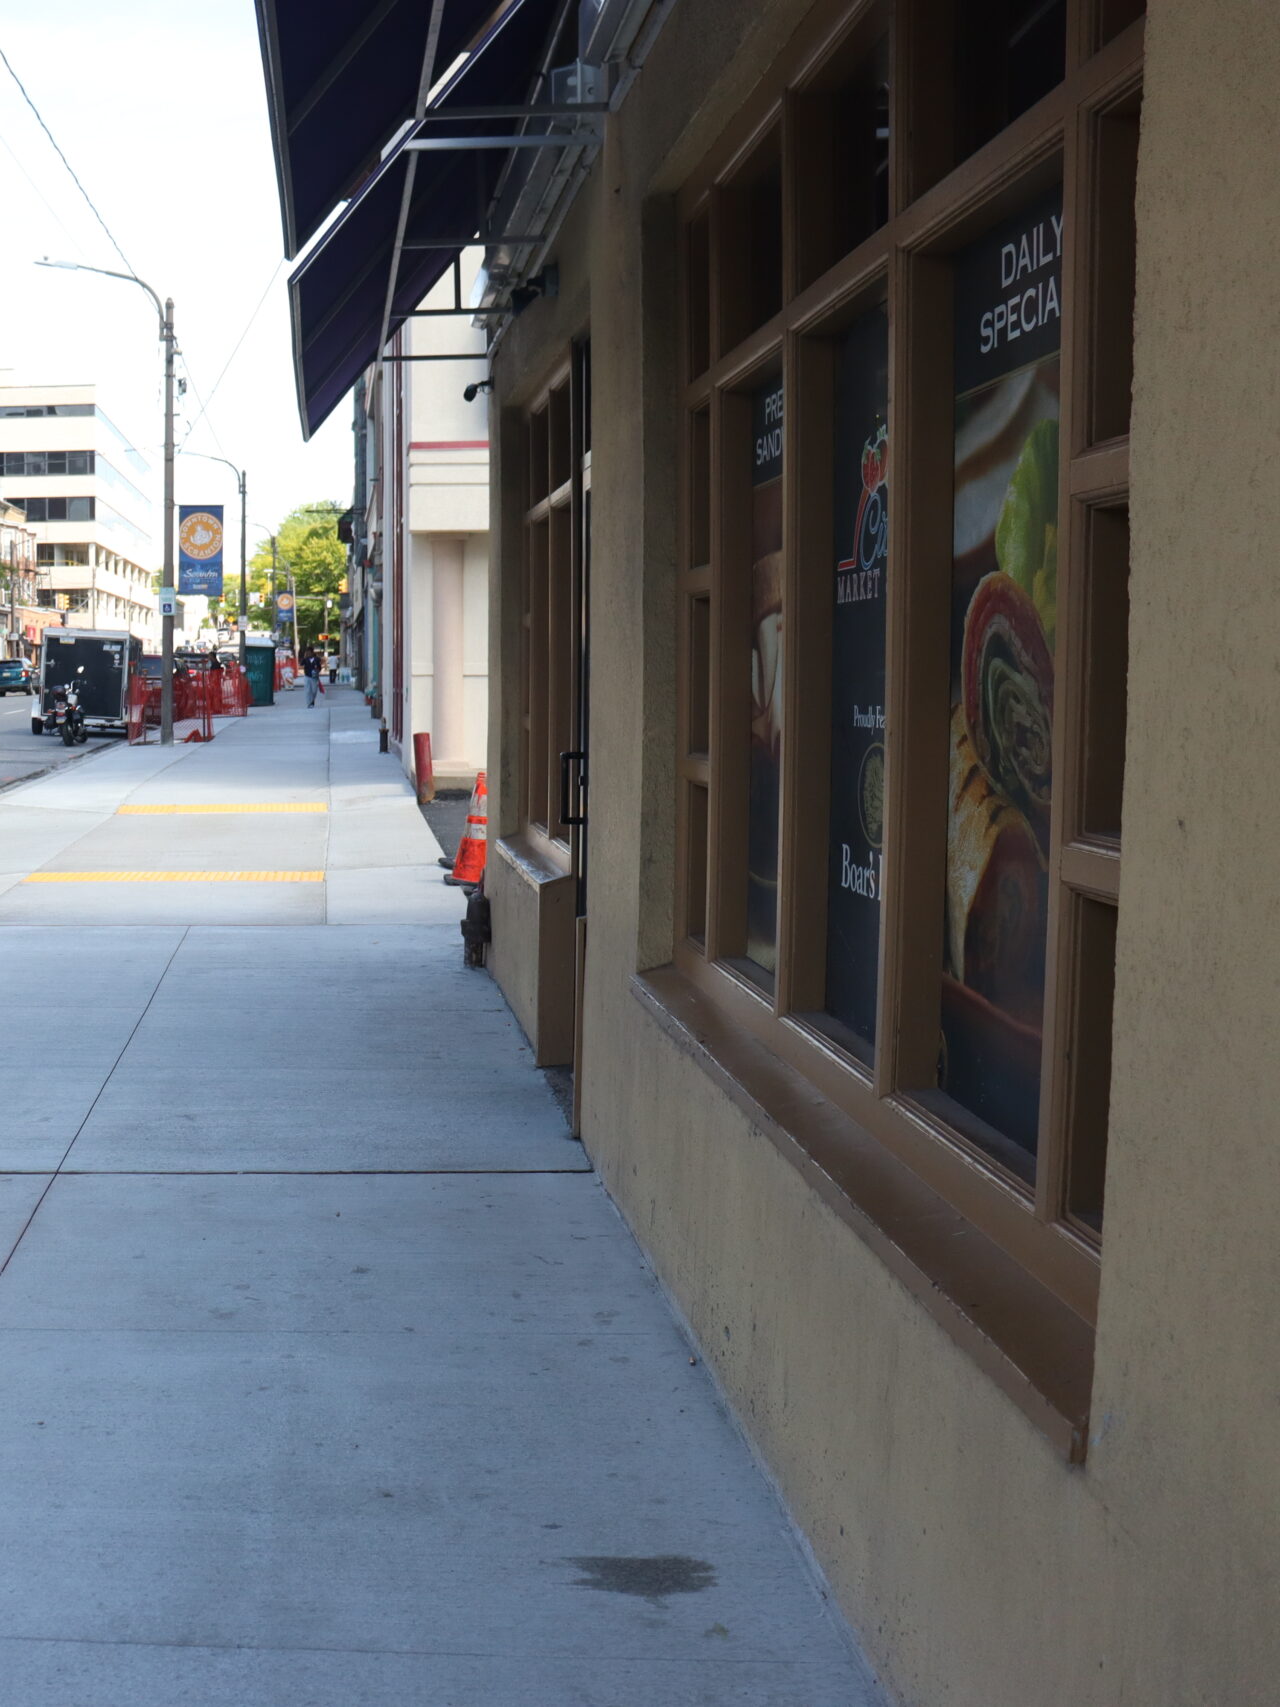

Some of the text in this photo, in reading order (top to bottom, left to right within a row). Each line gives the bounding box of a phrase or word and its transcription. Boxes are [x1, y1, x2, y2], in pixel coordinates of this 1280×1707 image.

[1001, 213, 1064, 289] DAILY
[756, 426, 784, 466] SAND
[182, 516, 219, 537] DOWNTOWN
[183, 535, 221, 556] SCRANTON
[837, 568, 880, 604] MARKET
[853, 704, 876, 736] Proudly
[841, 843, 875, 899] Boar's
